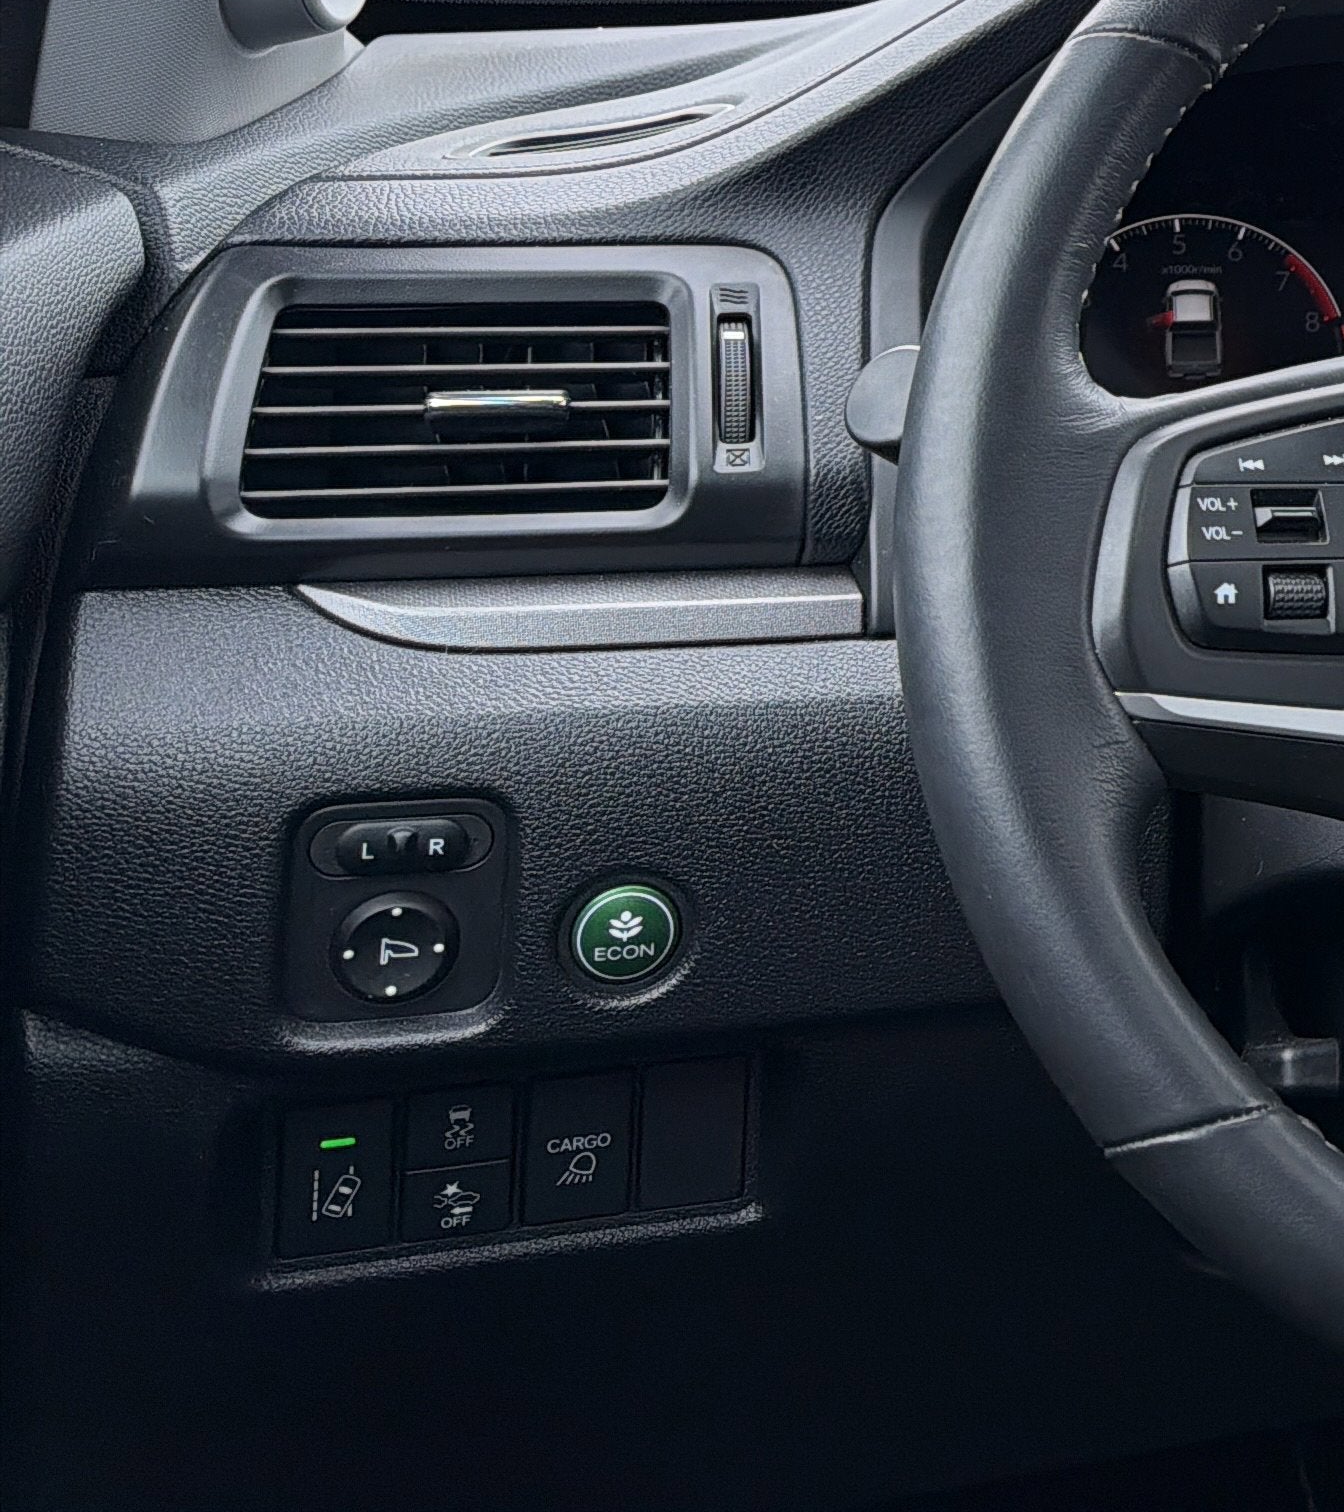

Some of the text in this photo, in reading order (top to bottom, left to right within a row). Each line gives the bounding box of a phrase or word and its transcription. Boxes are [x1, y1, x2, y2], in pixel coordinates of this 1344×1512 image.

[1172, 235, 1187, 256] 5
[1228, 243, 1243, 262] 6
[1113, 253, 1129, 272] 4
[1275, 271, 1290, 291] 7
[1305, 312, 1320, 332] 8
[1196, 497, 1239, 512] VOL+
[361, 838, 445, 861] L R
[593, 942, 655, 962] ECON
[443, 1135, 475, 1151] OFF
[546, 1132, 612, 1155] CARGO
[440, 1215, 472, 1229] OFF
